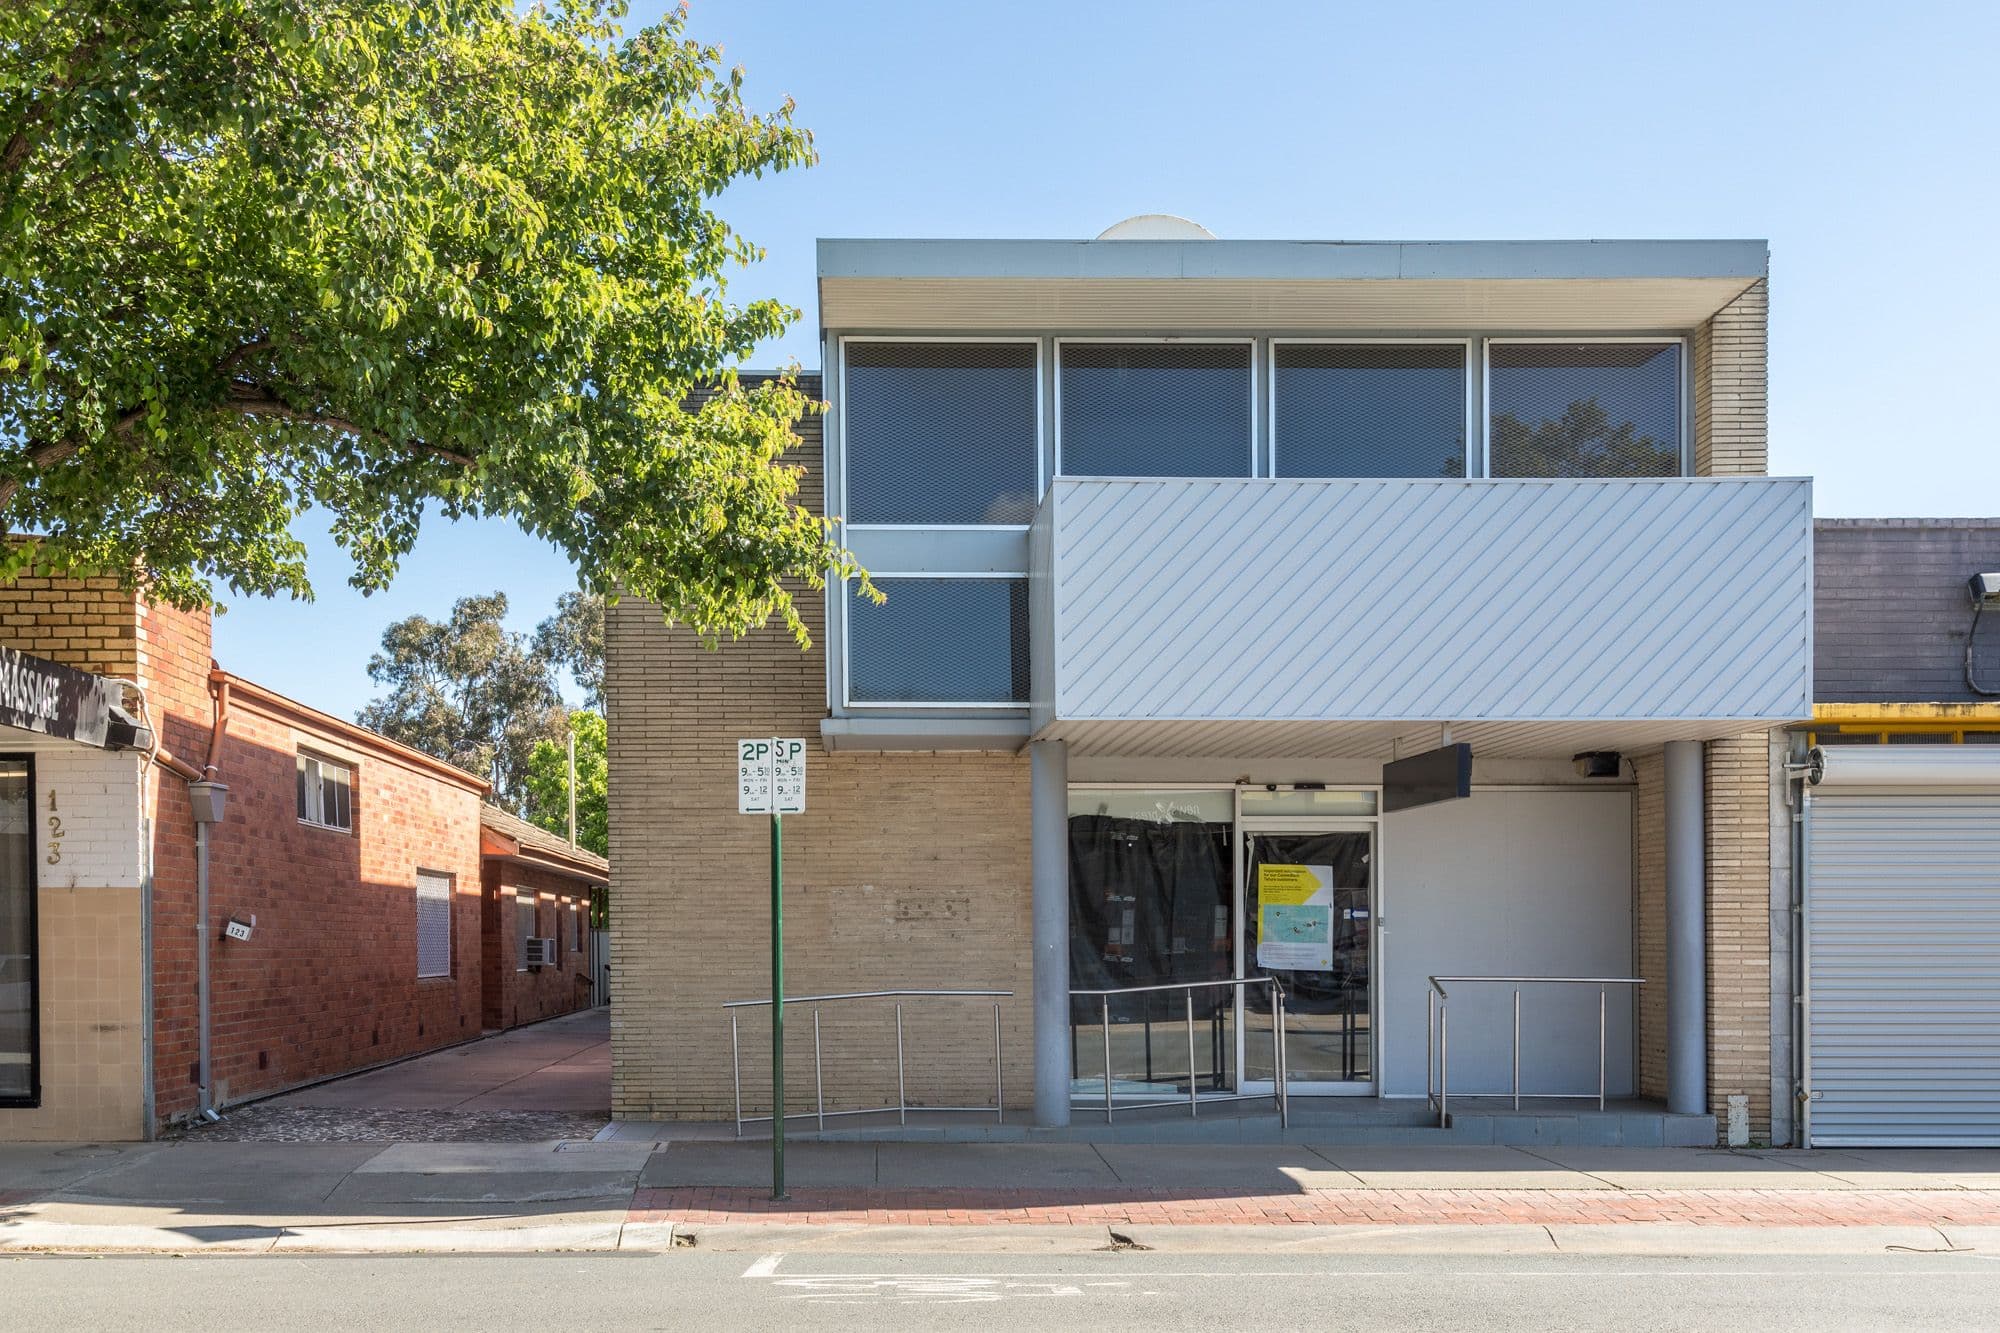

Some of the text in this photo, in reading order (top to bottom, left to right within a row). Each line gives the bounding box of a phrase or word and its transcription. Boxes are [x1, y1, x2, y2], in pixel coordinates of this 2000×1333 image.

[0, 660, 59, 721] MASSAGE
[742, 744, 768, 760] 2P
[230, 926, 245, 938] 123
